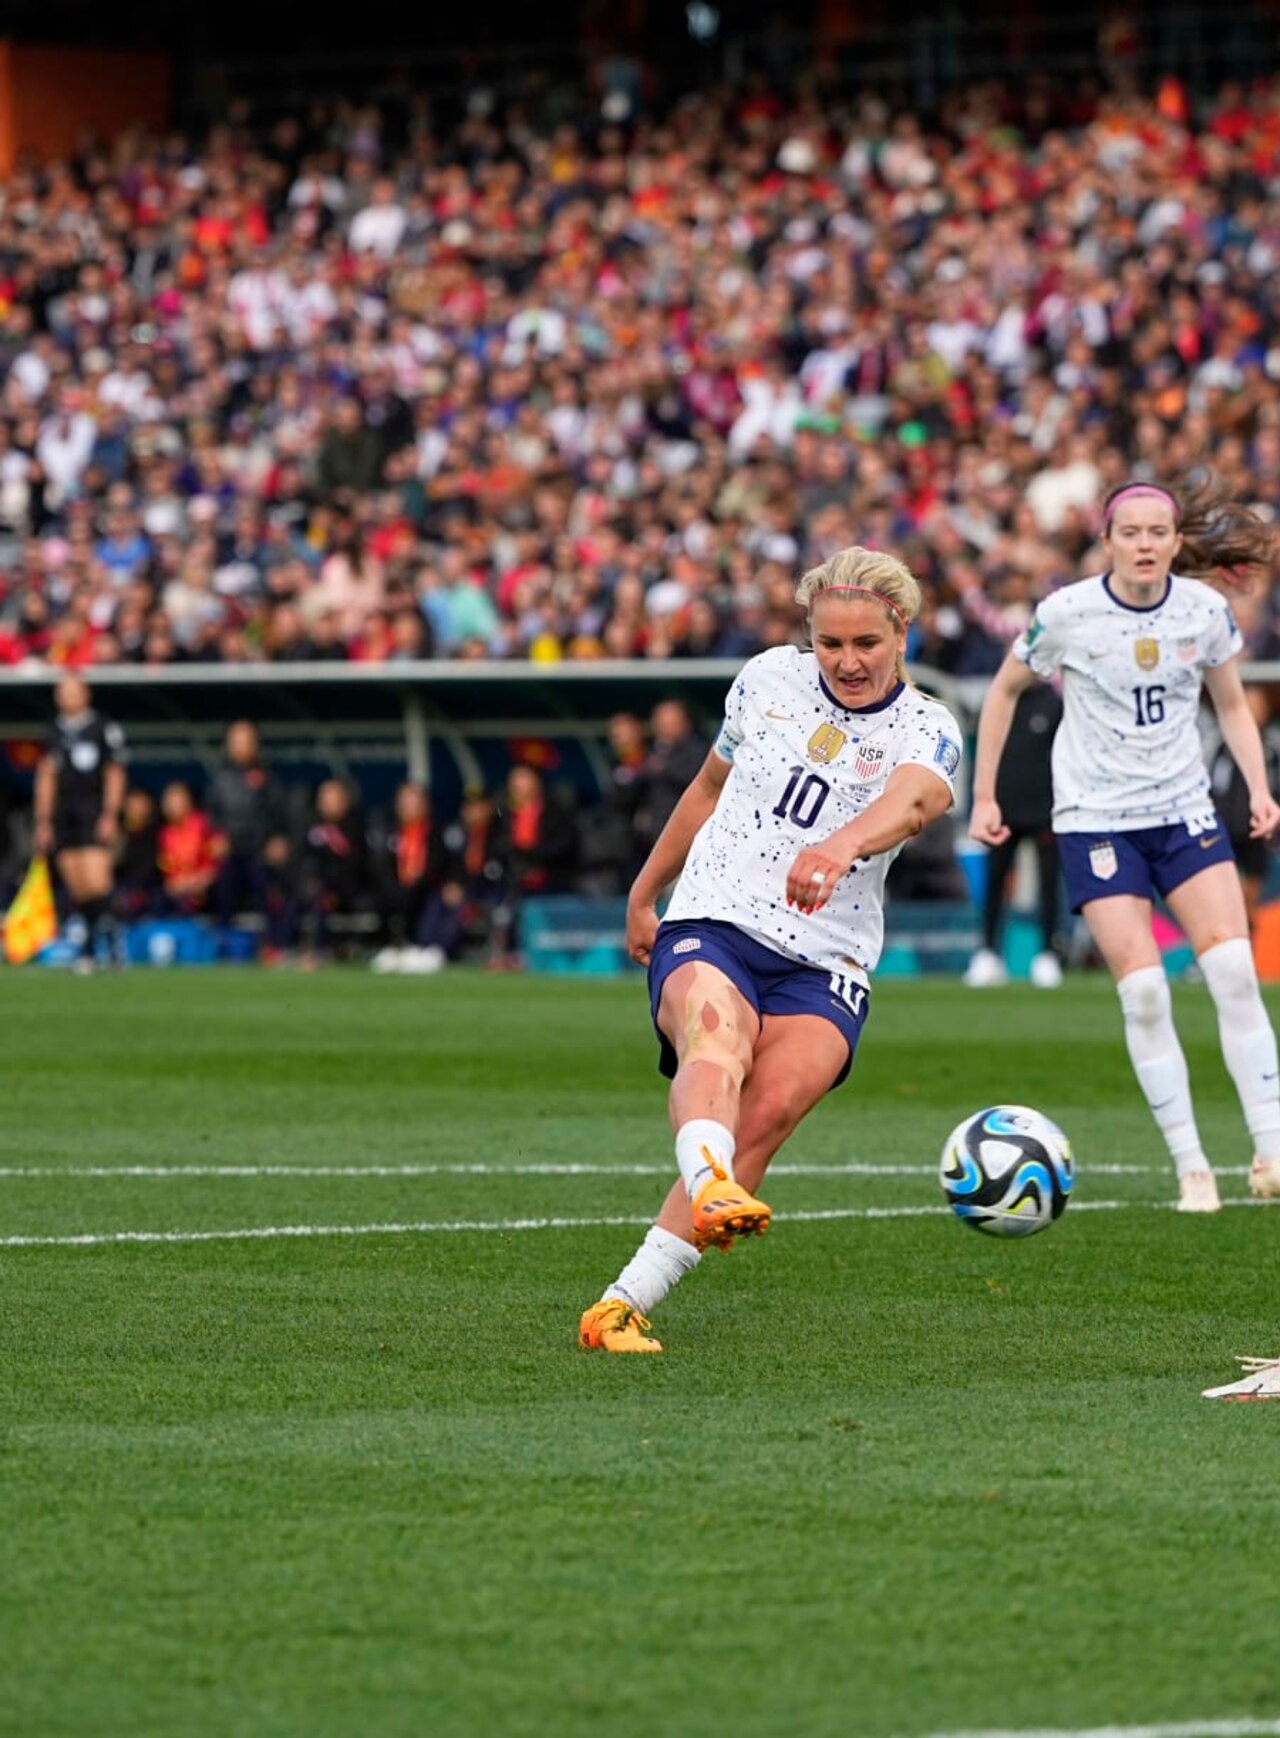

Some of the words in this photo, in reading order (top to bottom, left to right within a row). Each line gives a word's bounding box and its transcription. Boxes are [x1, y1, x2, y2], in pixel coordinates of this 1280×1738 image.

[1132, 685, 1166, 726] 16
[859, 746, 884, 762] USA
[772, 765, 830, 829] 10
